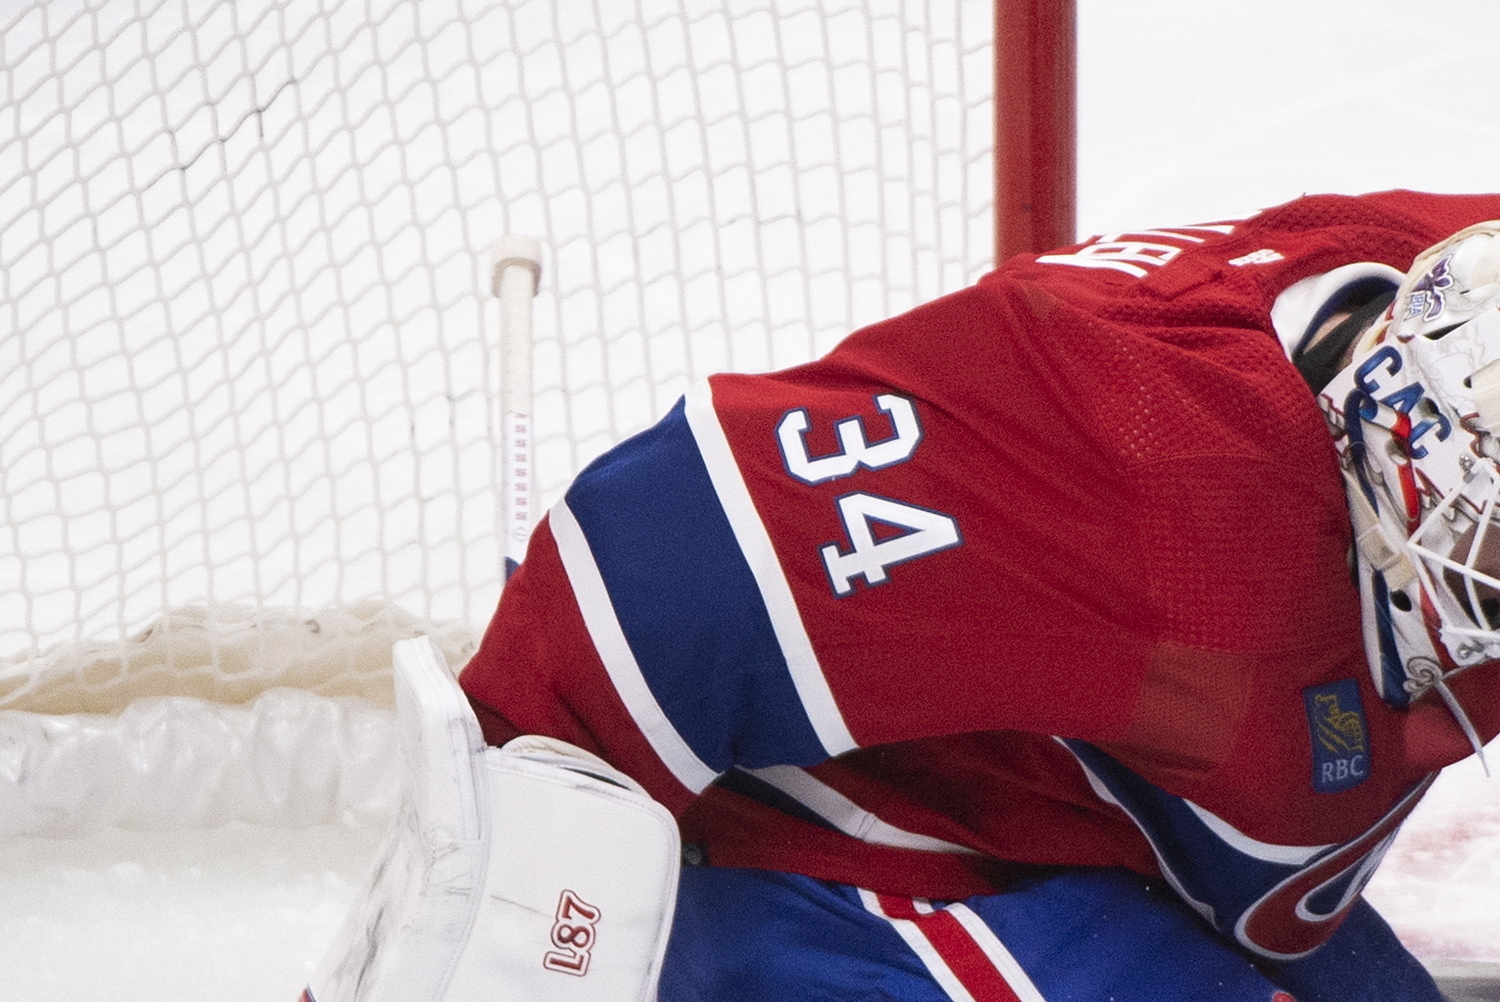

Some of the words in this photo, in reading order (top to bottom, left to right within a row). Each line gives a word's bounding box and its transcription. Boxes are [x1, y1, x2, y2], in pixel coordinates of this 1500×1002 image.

[773, 392, 963, 599] 34
[1320, 754, 1365, 784] RBC
[544, 891, 600, 975] L87
